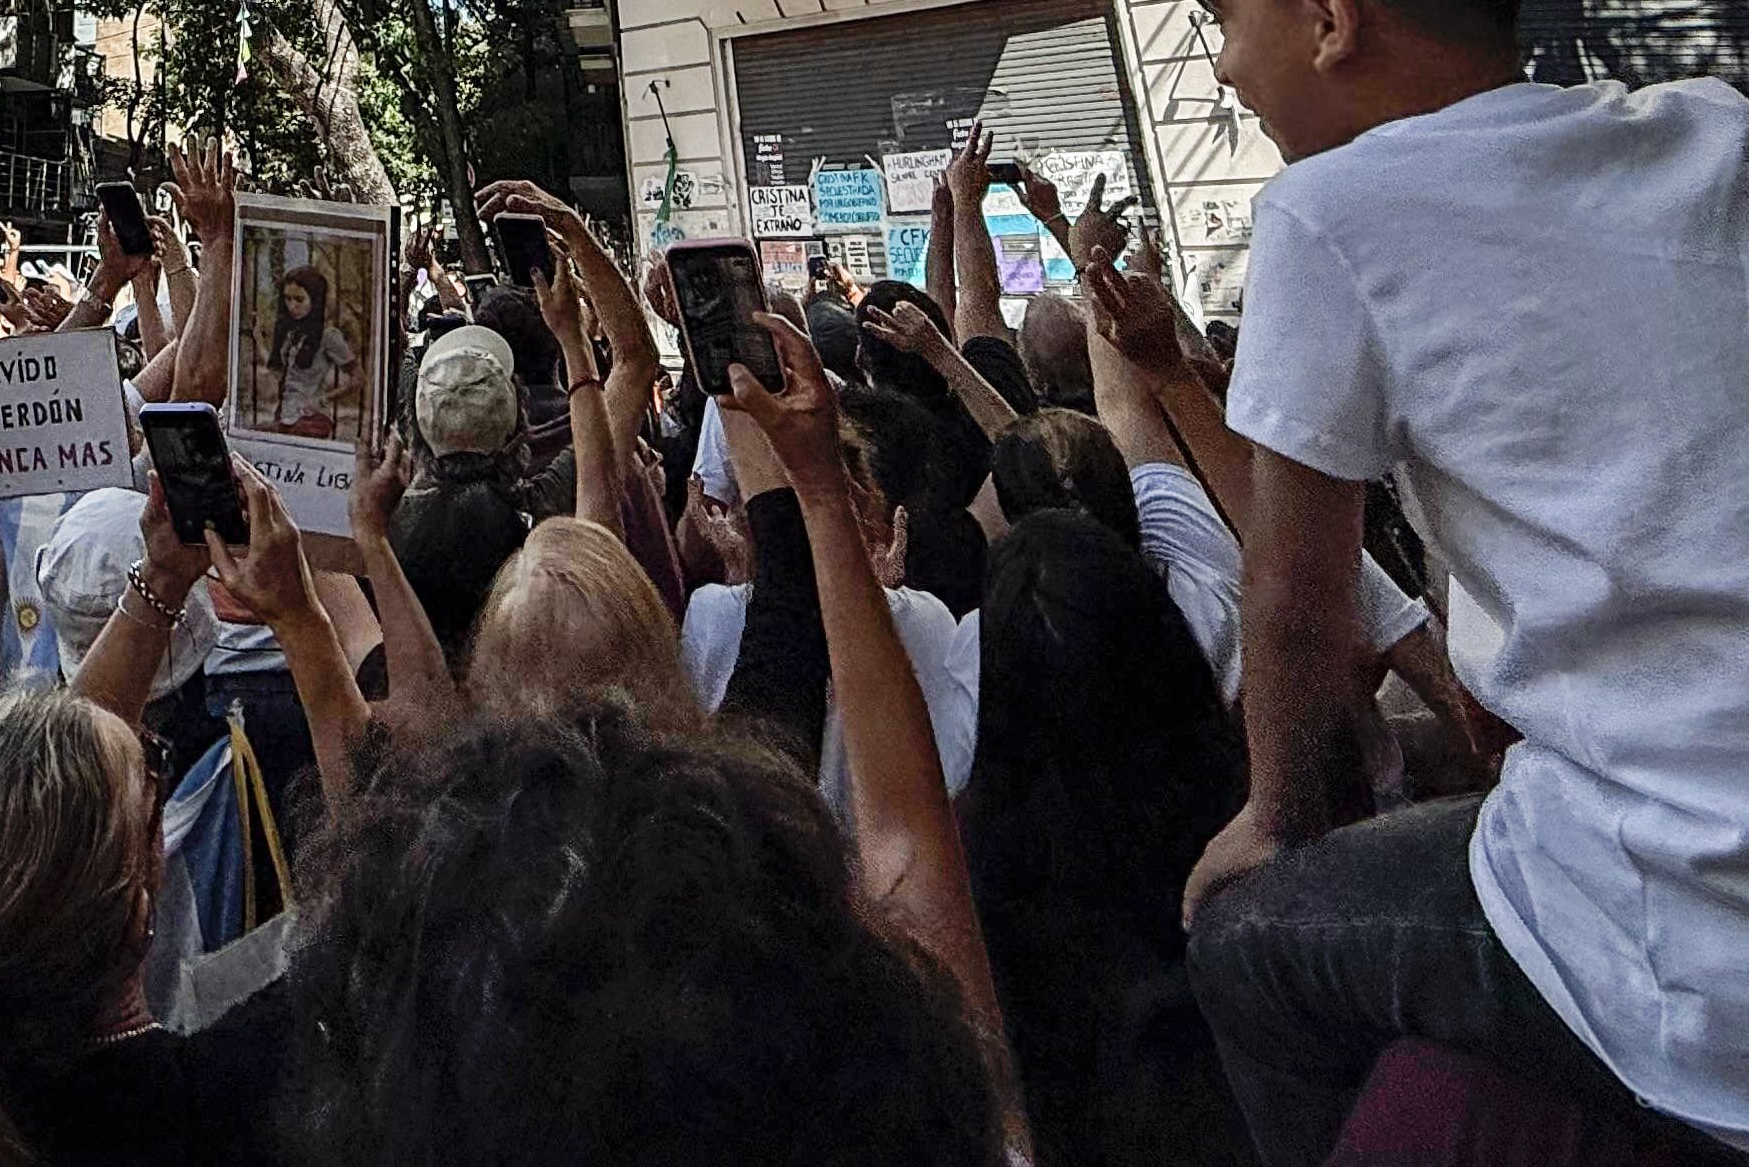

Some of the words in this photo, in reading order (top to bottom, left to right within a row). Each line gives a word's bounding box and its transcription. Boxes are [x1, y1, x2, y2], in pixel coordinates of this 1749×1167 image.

[751, 188, 807, 205] CRISTINA
[770, 204, 785, 218] TE
[756, 215, 802, 234] EXTRAÑO
[900, 228, 931, 246] CFK
[58, 440, 114, 469] MAS
[317, 465, 353, 491] LIB
